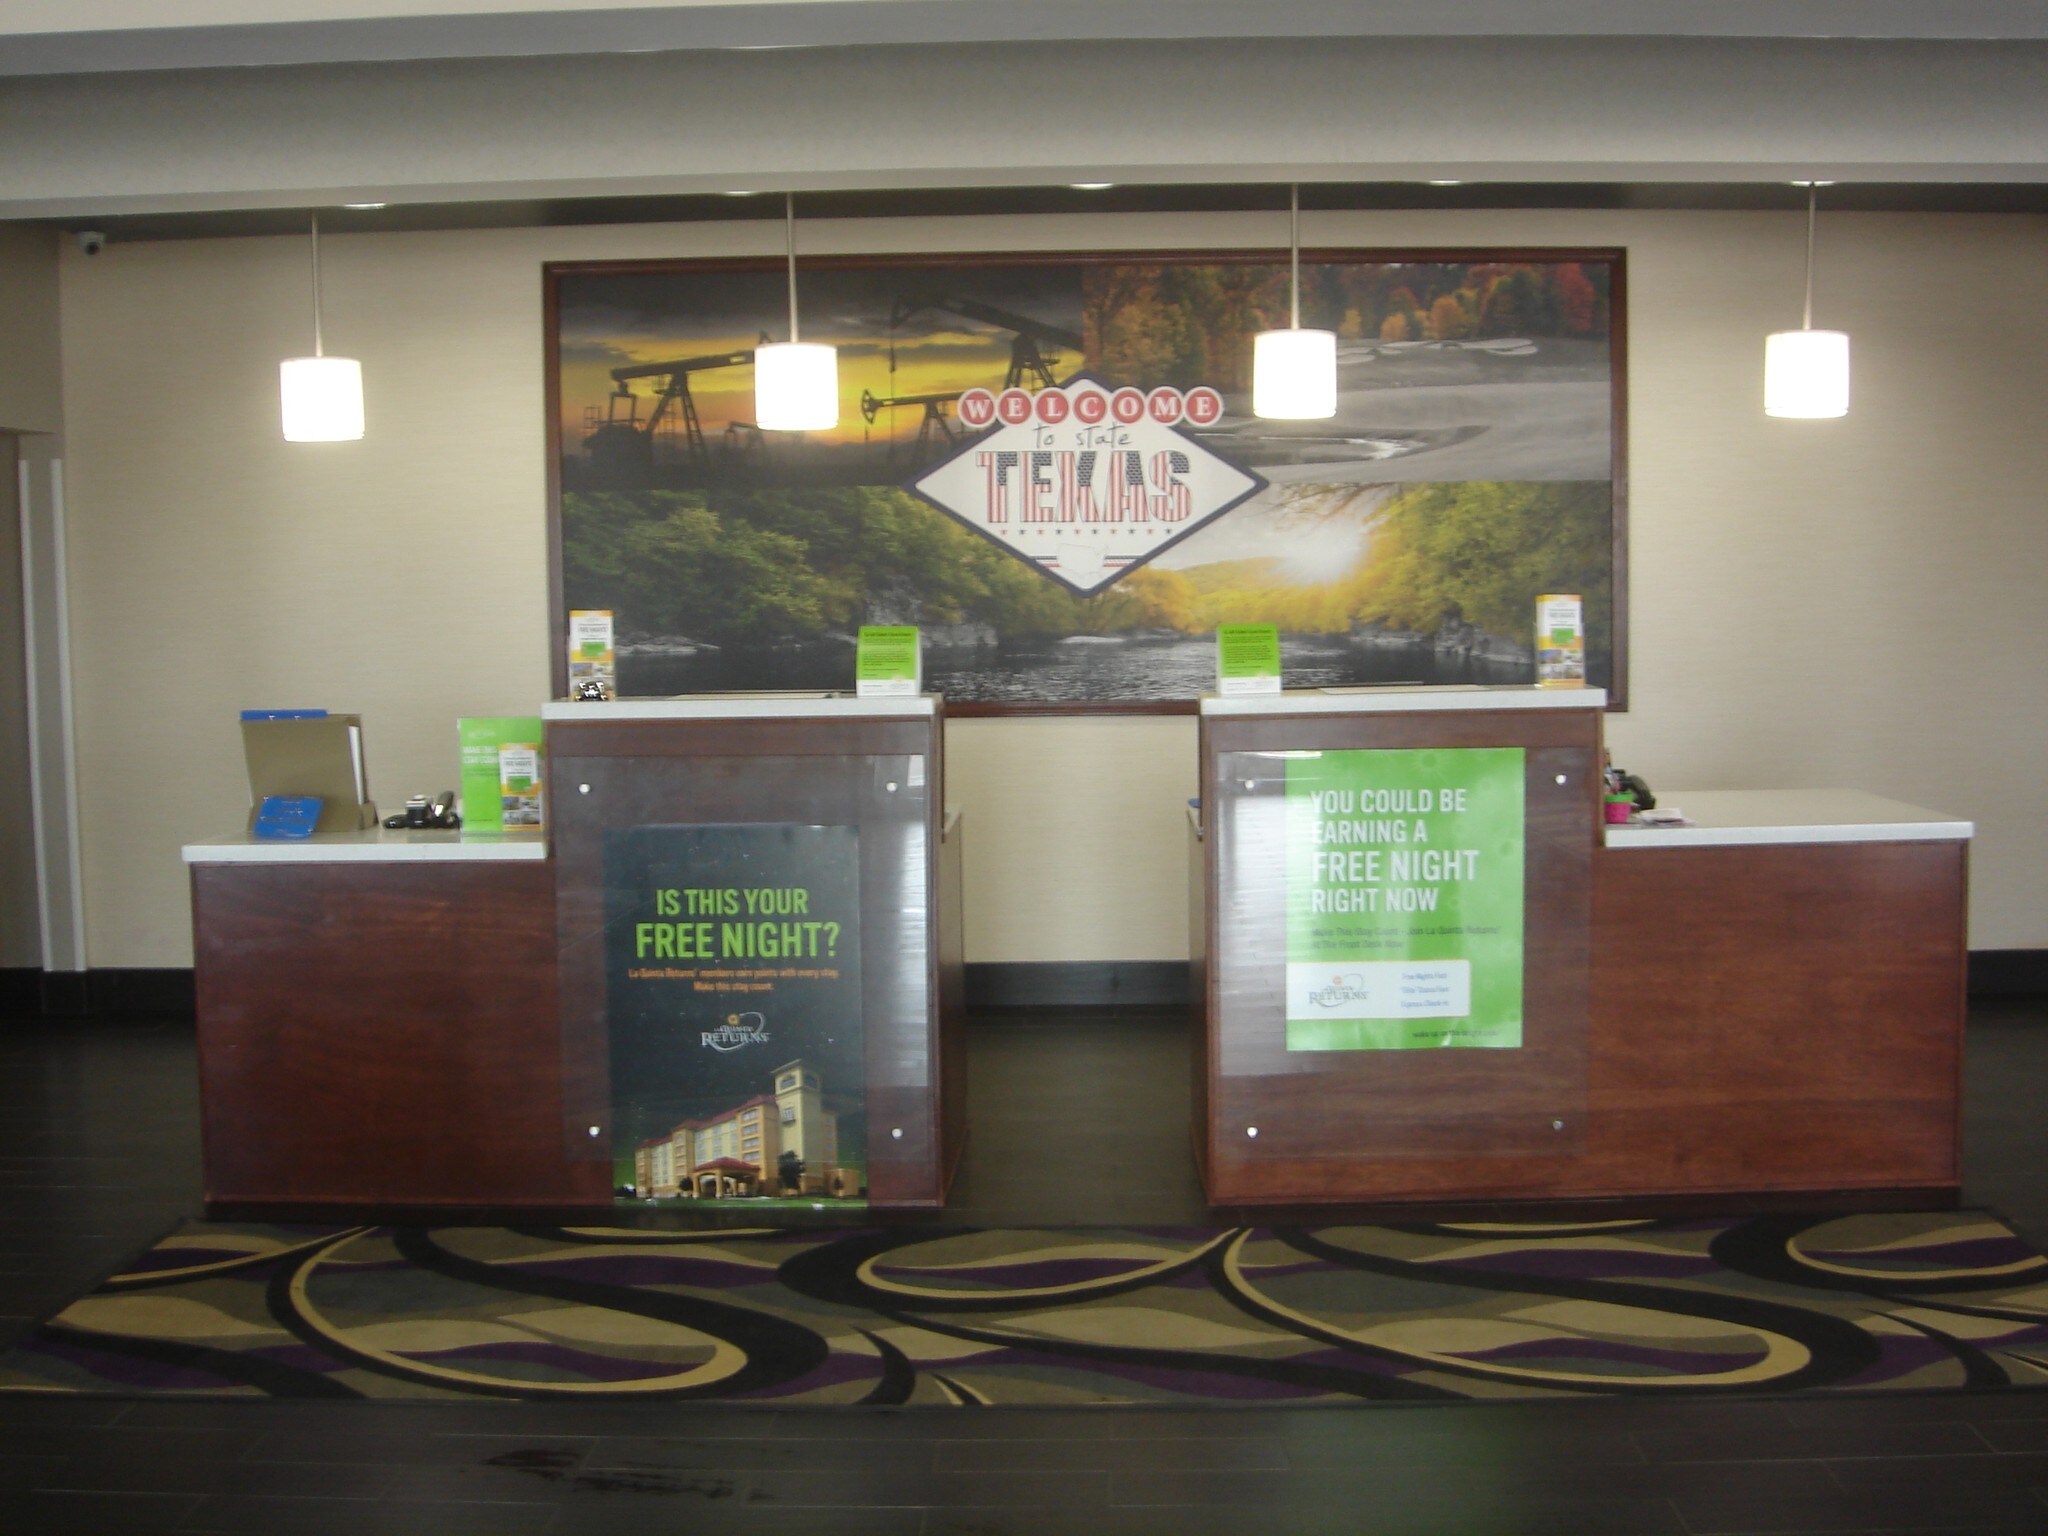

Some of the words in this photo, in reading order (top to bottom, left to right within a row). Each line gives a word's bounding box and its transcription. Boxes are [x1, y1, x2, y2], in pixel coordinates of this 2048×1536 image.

[964, 393, 1215, 420] WELCOME
[976, 450, 1192, 523] TEXAS
[1311, 790, 1353, 813] YOU
[1360, 789, 1433, 813] COULD
[1440, 789, 1467, 812] BE
[1413, 819, 1428, 843] A
[1312, 851, 1381, 882] FREE
[1390, 850, 1480, 881] NIGHT
[656, 889, 681, 916] IS
[684, 888, 740, 916] THIS
[744, 888, 809, 915] YOUR
[1312, 888, 1379, 912] RIGHT
[1386, 888, 1439, 912] NOW
[636, 922, 715, 958] FREE
[721, 922, 841, 958] NIGHT?
[701, 1032, 769, 1046] RETURNS
